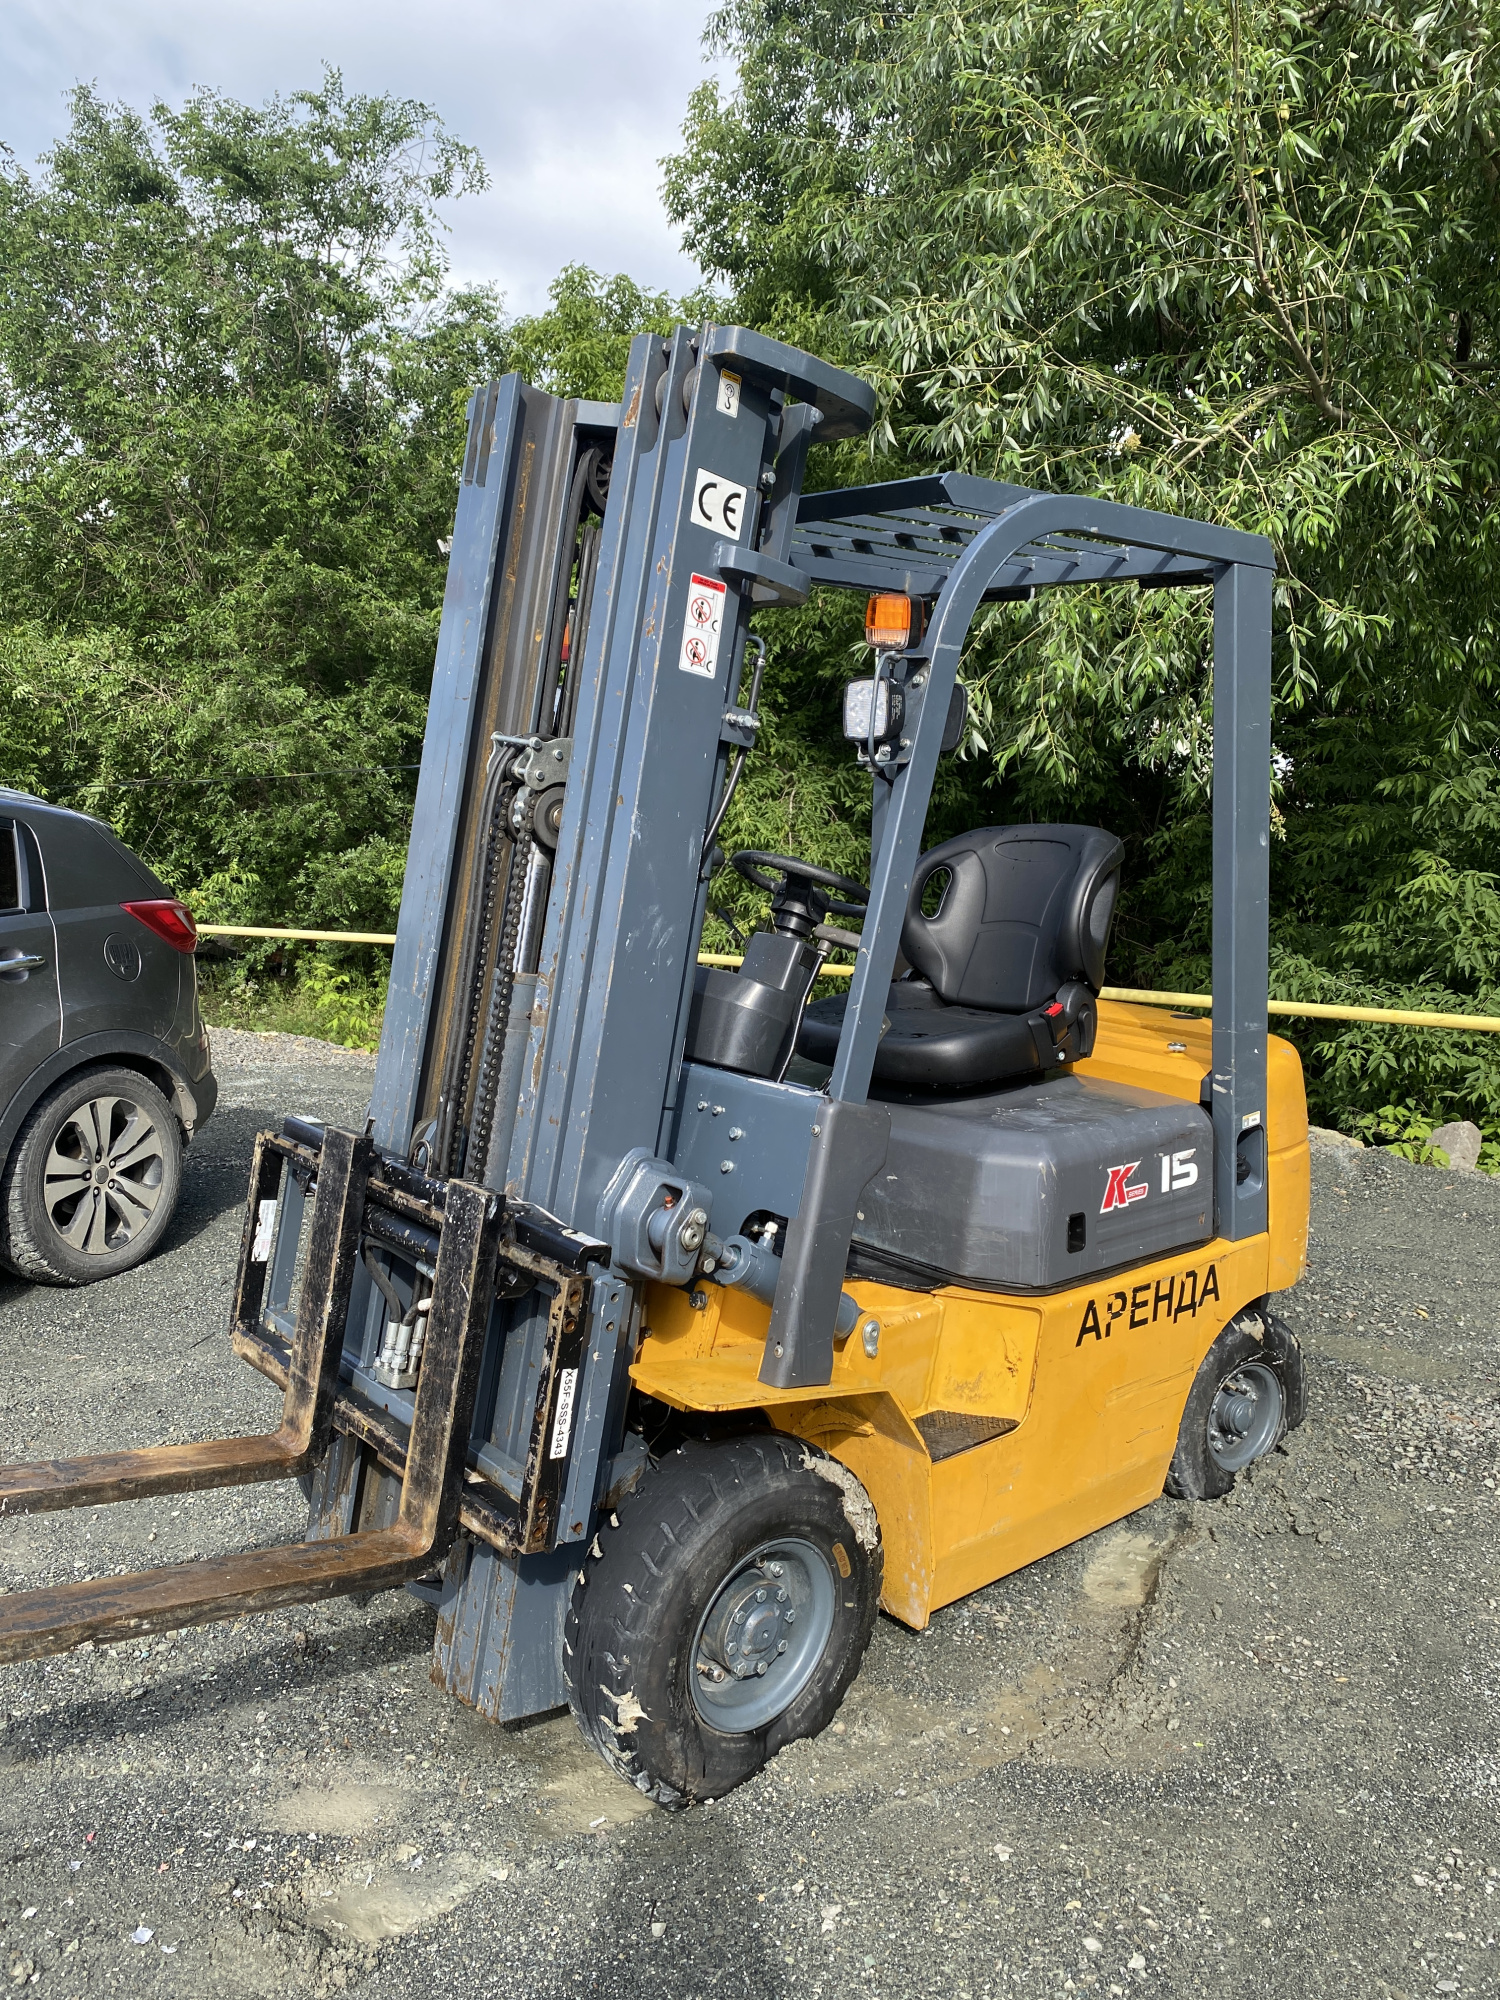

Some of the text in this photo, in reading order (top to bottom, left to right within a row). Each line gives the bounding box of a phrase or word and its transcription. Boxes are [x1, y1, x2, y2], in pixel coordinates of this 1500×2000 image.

[698, 482, 741, 532] CE
[1100, 1161, 1141, 1214] K
[1161, 1148, 1199, 1193] 15
[1075, 1264, 1220, 1348] АРЕНДА
[554, 1371, 574, 1456] X55F-SSS-4343
